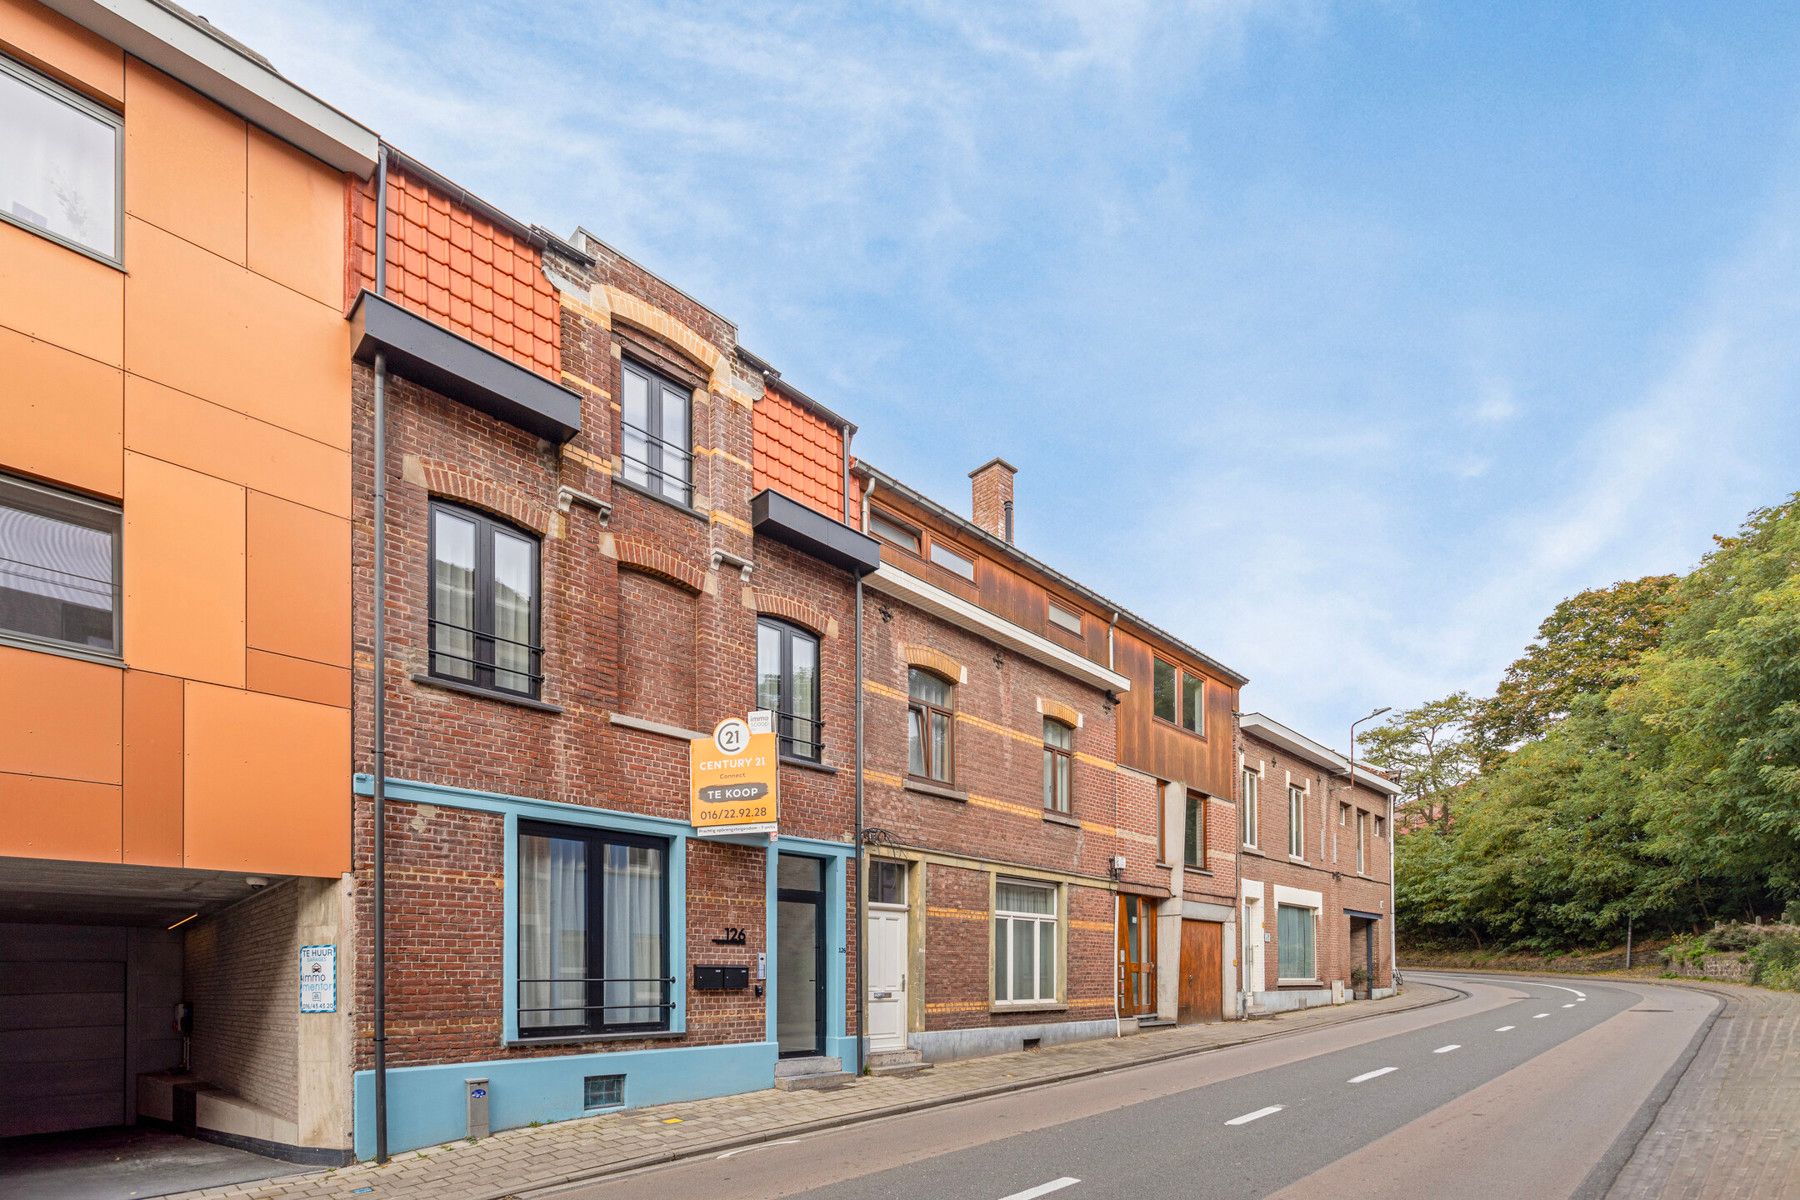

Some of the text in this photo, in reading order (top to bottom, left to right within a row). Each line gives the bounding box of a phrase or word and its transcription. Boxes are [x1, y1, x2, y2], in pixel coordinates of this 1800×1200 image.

[699, 756, 765, 770] CENTURY 21
[707, 787, 758, 799] TE KOOP
[700, 807, 767, 820] 016/22.92.28
[724, 927, 746, 941] 126
[303, 948, 333, 957] TE HUUR
[302, 974, 326, 982] immo
[302, 983, 332, 991] mentor
